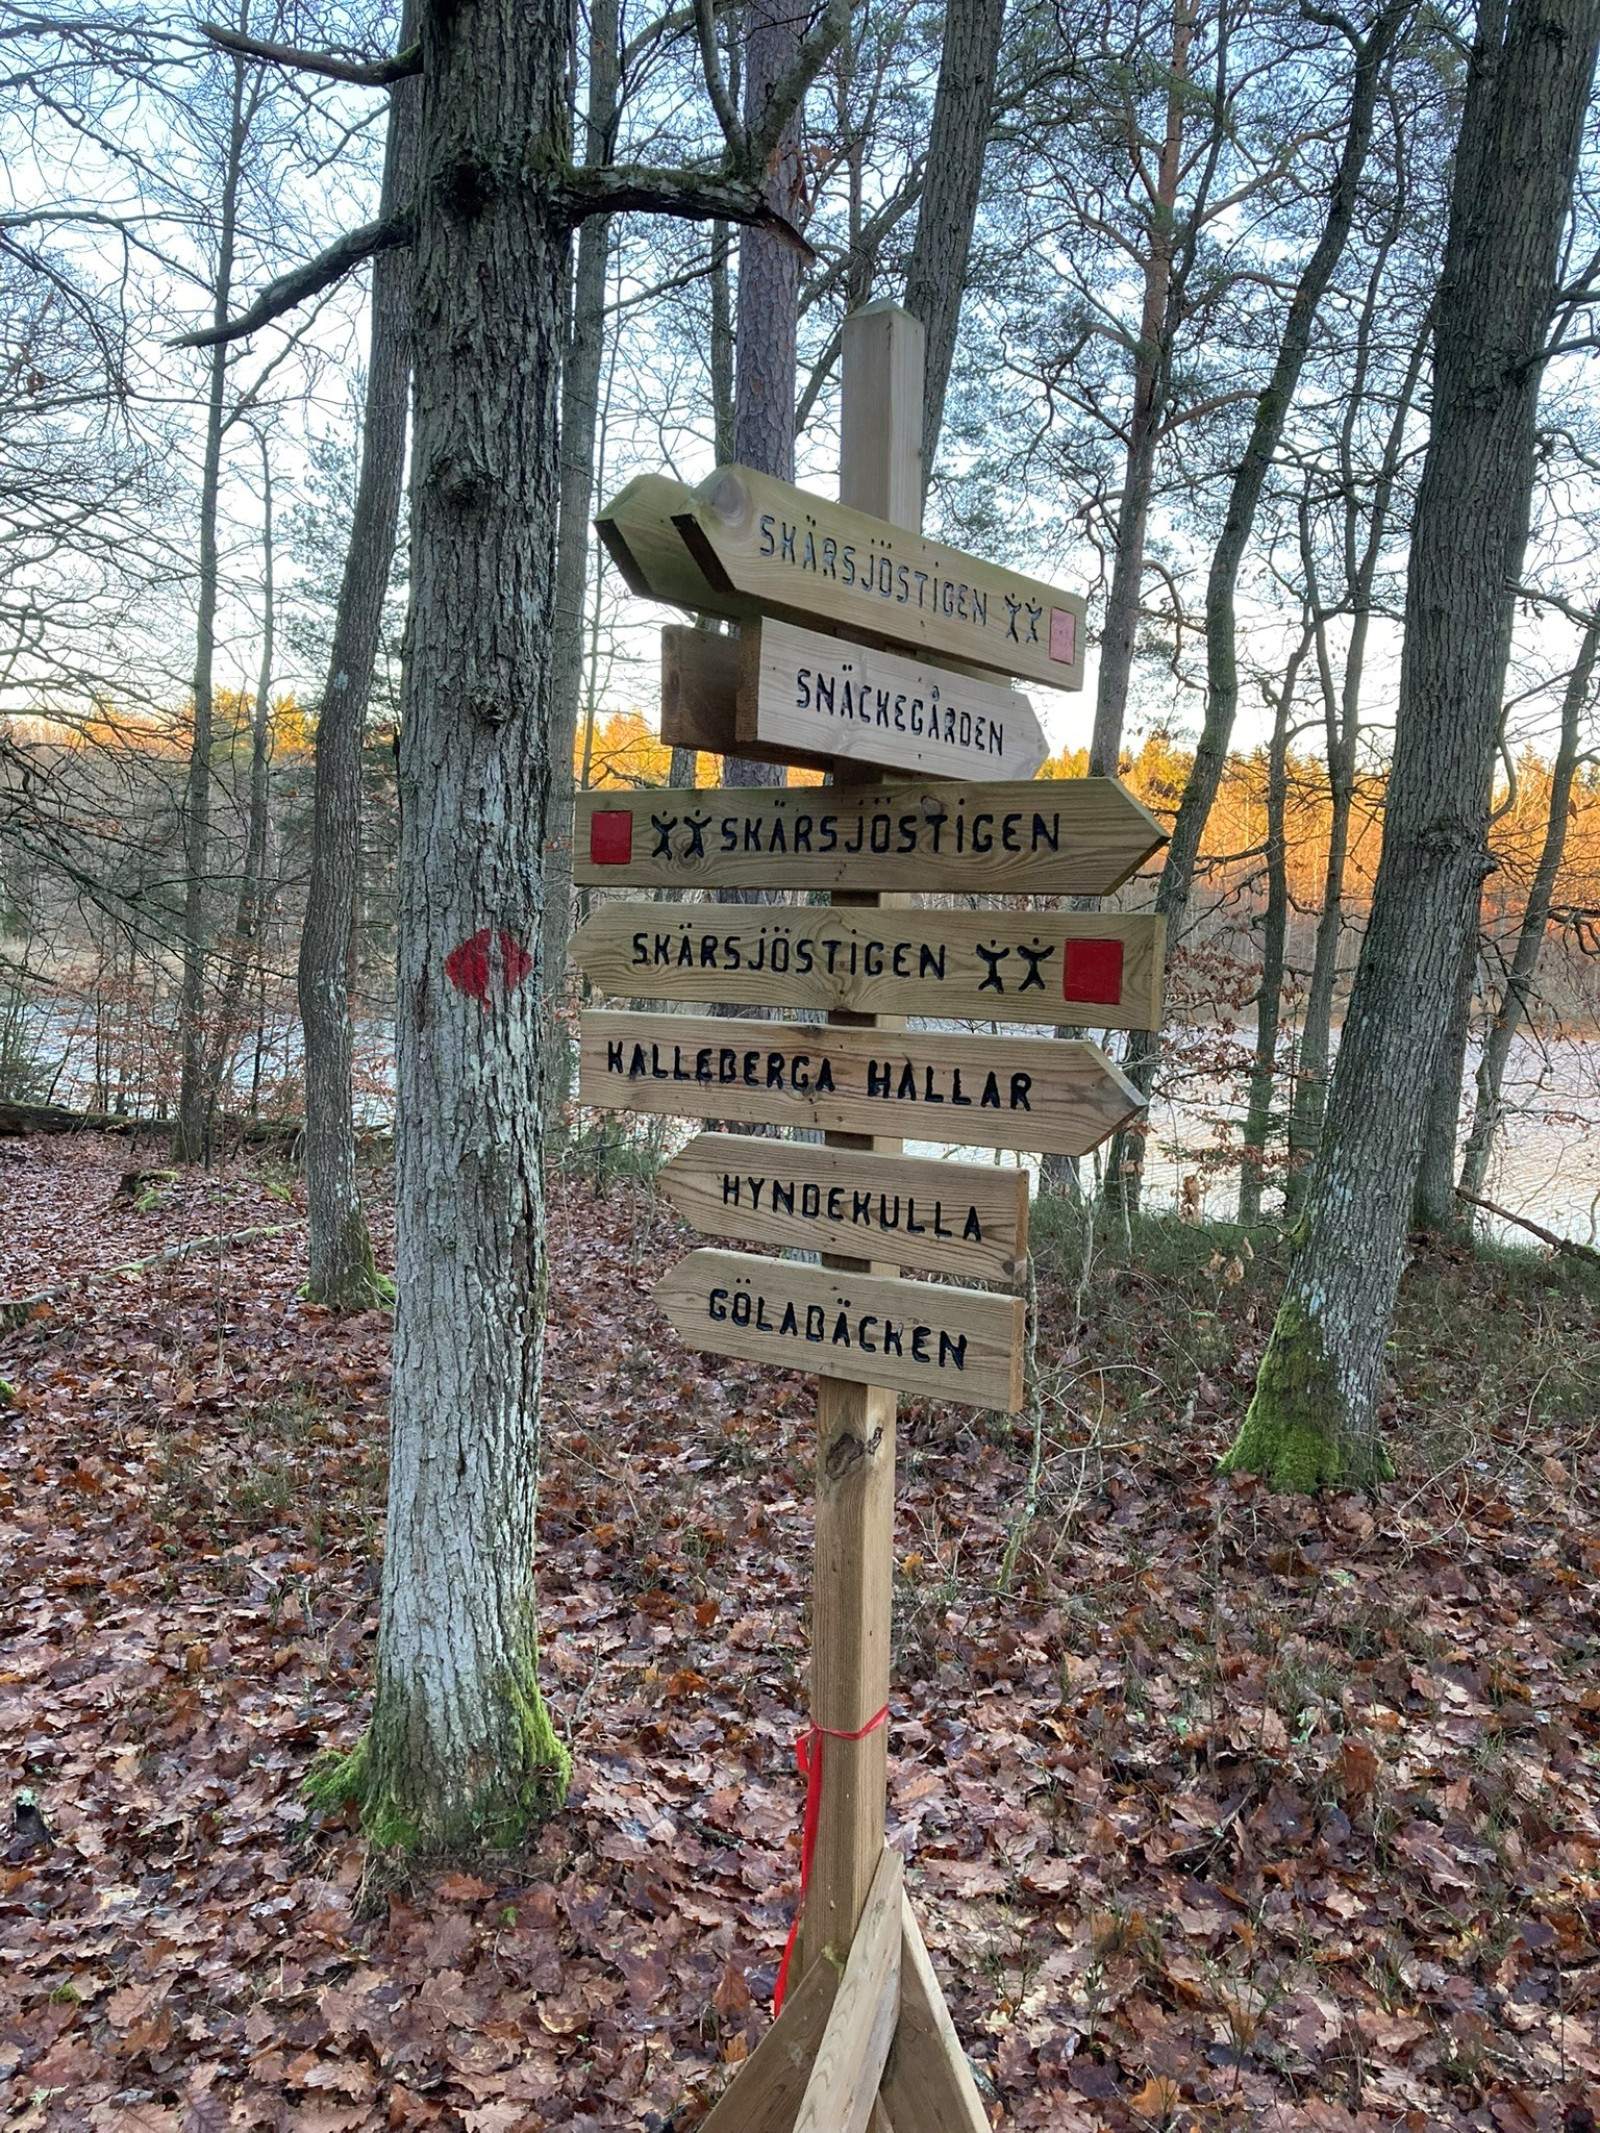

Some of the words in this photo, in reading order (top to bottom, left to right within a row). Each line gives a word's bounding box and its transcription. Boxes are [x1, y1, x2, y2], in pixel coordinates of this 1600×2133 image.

[759, 513, 989, 628] SKÄRSJÖSTIGEN
[796, 663, 1005, 758] SNÄCKEGÅRDEN
[720, 797, 1062, 855] SKÄRSJÖSTIGEN
[632, 922, 947, 981] SKÄRSJÖSTIGEN
[606, 1040, 837, 1093] KALLEBERGA
[866, 1059, 1034, 1112] HALLAR
[722, 1172, 984, 1243] HYNDEKULLA
[708, 1277, 969, 1372] GÖLABÄCKEN
